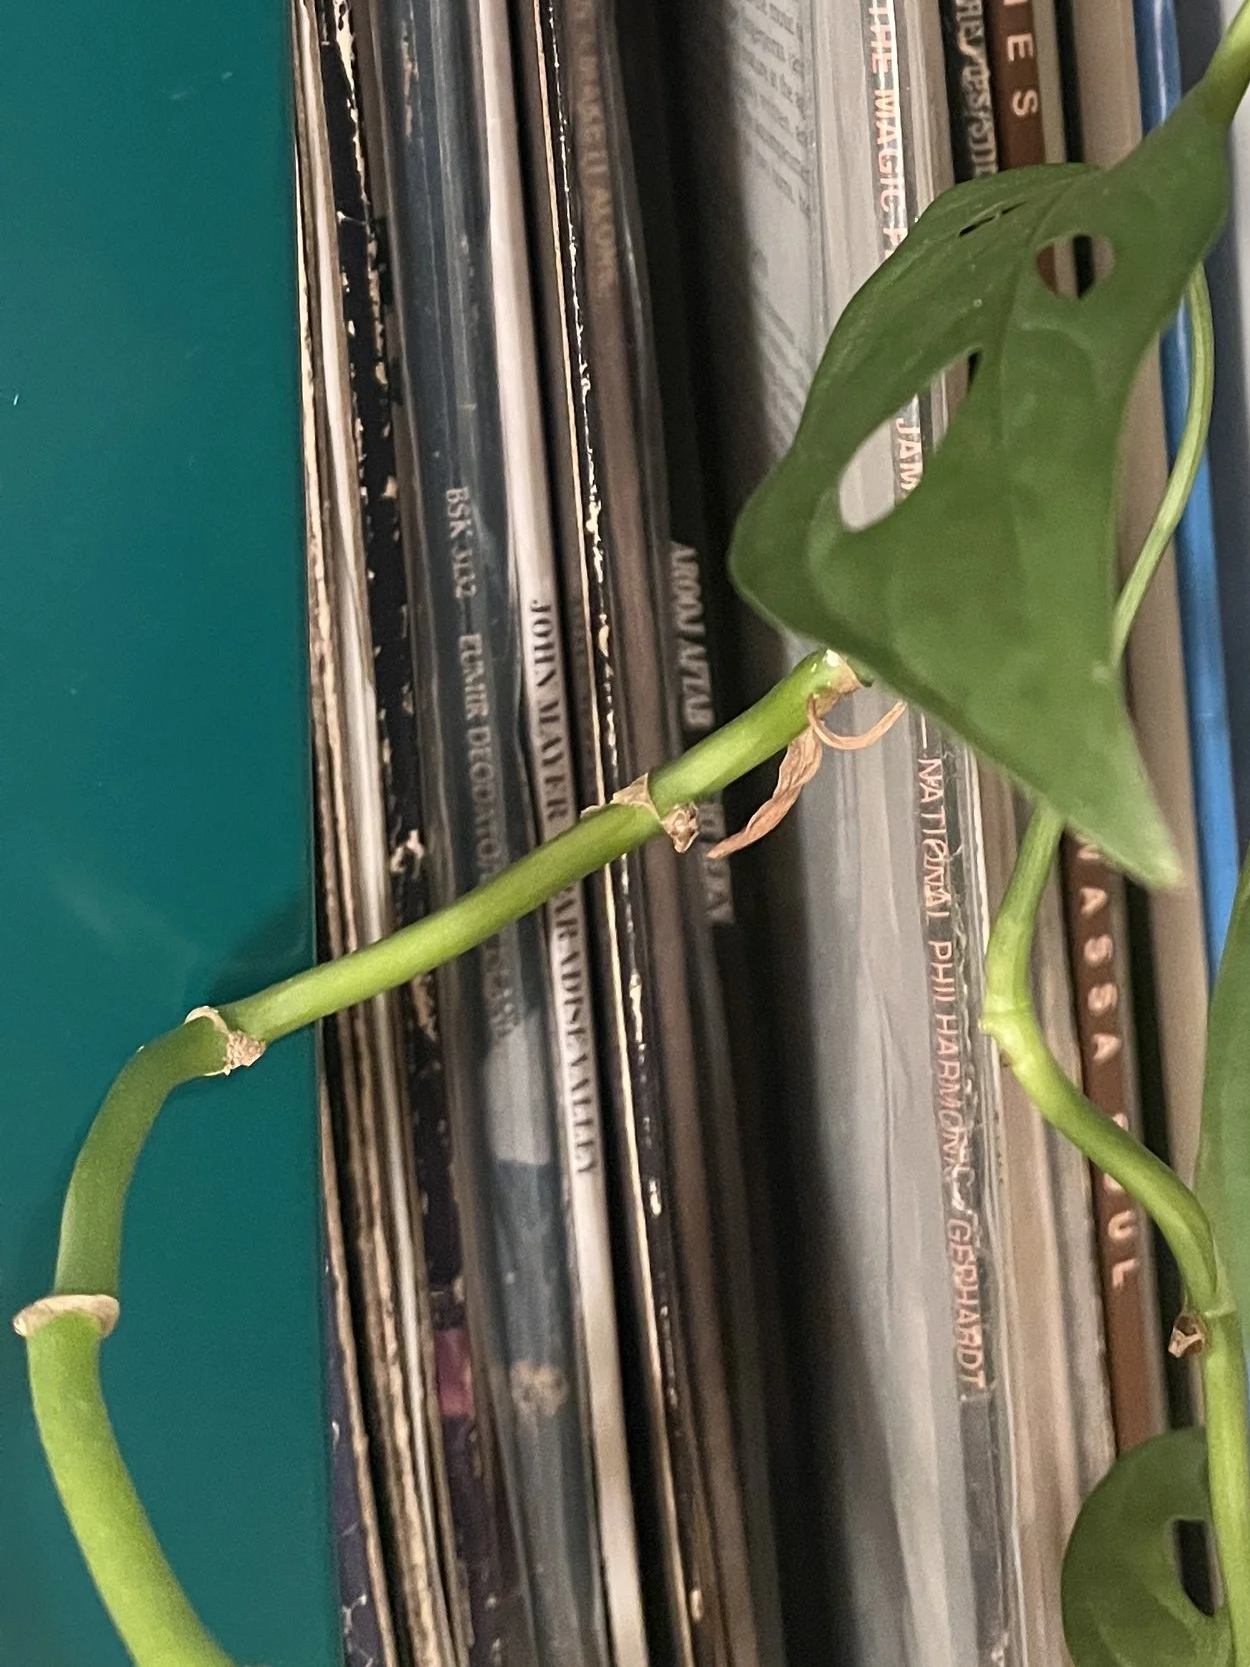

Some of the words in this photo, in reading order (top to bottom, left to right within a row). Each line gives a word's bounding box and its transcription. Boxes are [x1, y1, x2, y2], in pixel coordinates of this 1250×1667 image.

[867, 5, 896, 74] THE
[873, 88, 904, 213] MAGIC
[446, 486, 473, 537] BSK
[670, 541, 707, 635] AROOJ
[458, 633, 489, 720] EUMIR
[530, 599, 557, 688] JOHN
[678, 638, 716, 729] AFTAB
[895, 417, 923, 492] JAM
[917, 758, 951, 926] NATIONAL
[537, 699, 569, 823] MAYER
[555, 885, 587, 1043] ARADISE
[569, 1052, 599, 1174] VALLEY
[1075, 832, 1123, 1065] NASSA
[1103, 1113, 1140, 1289] UL
